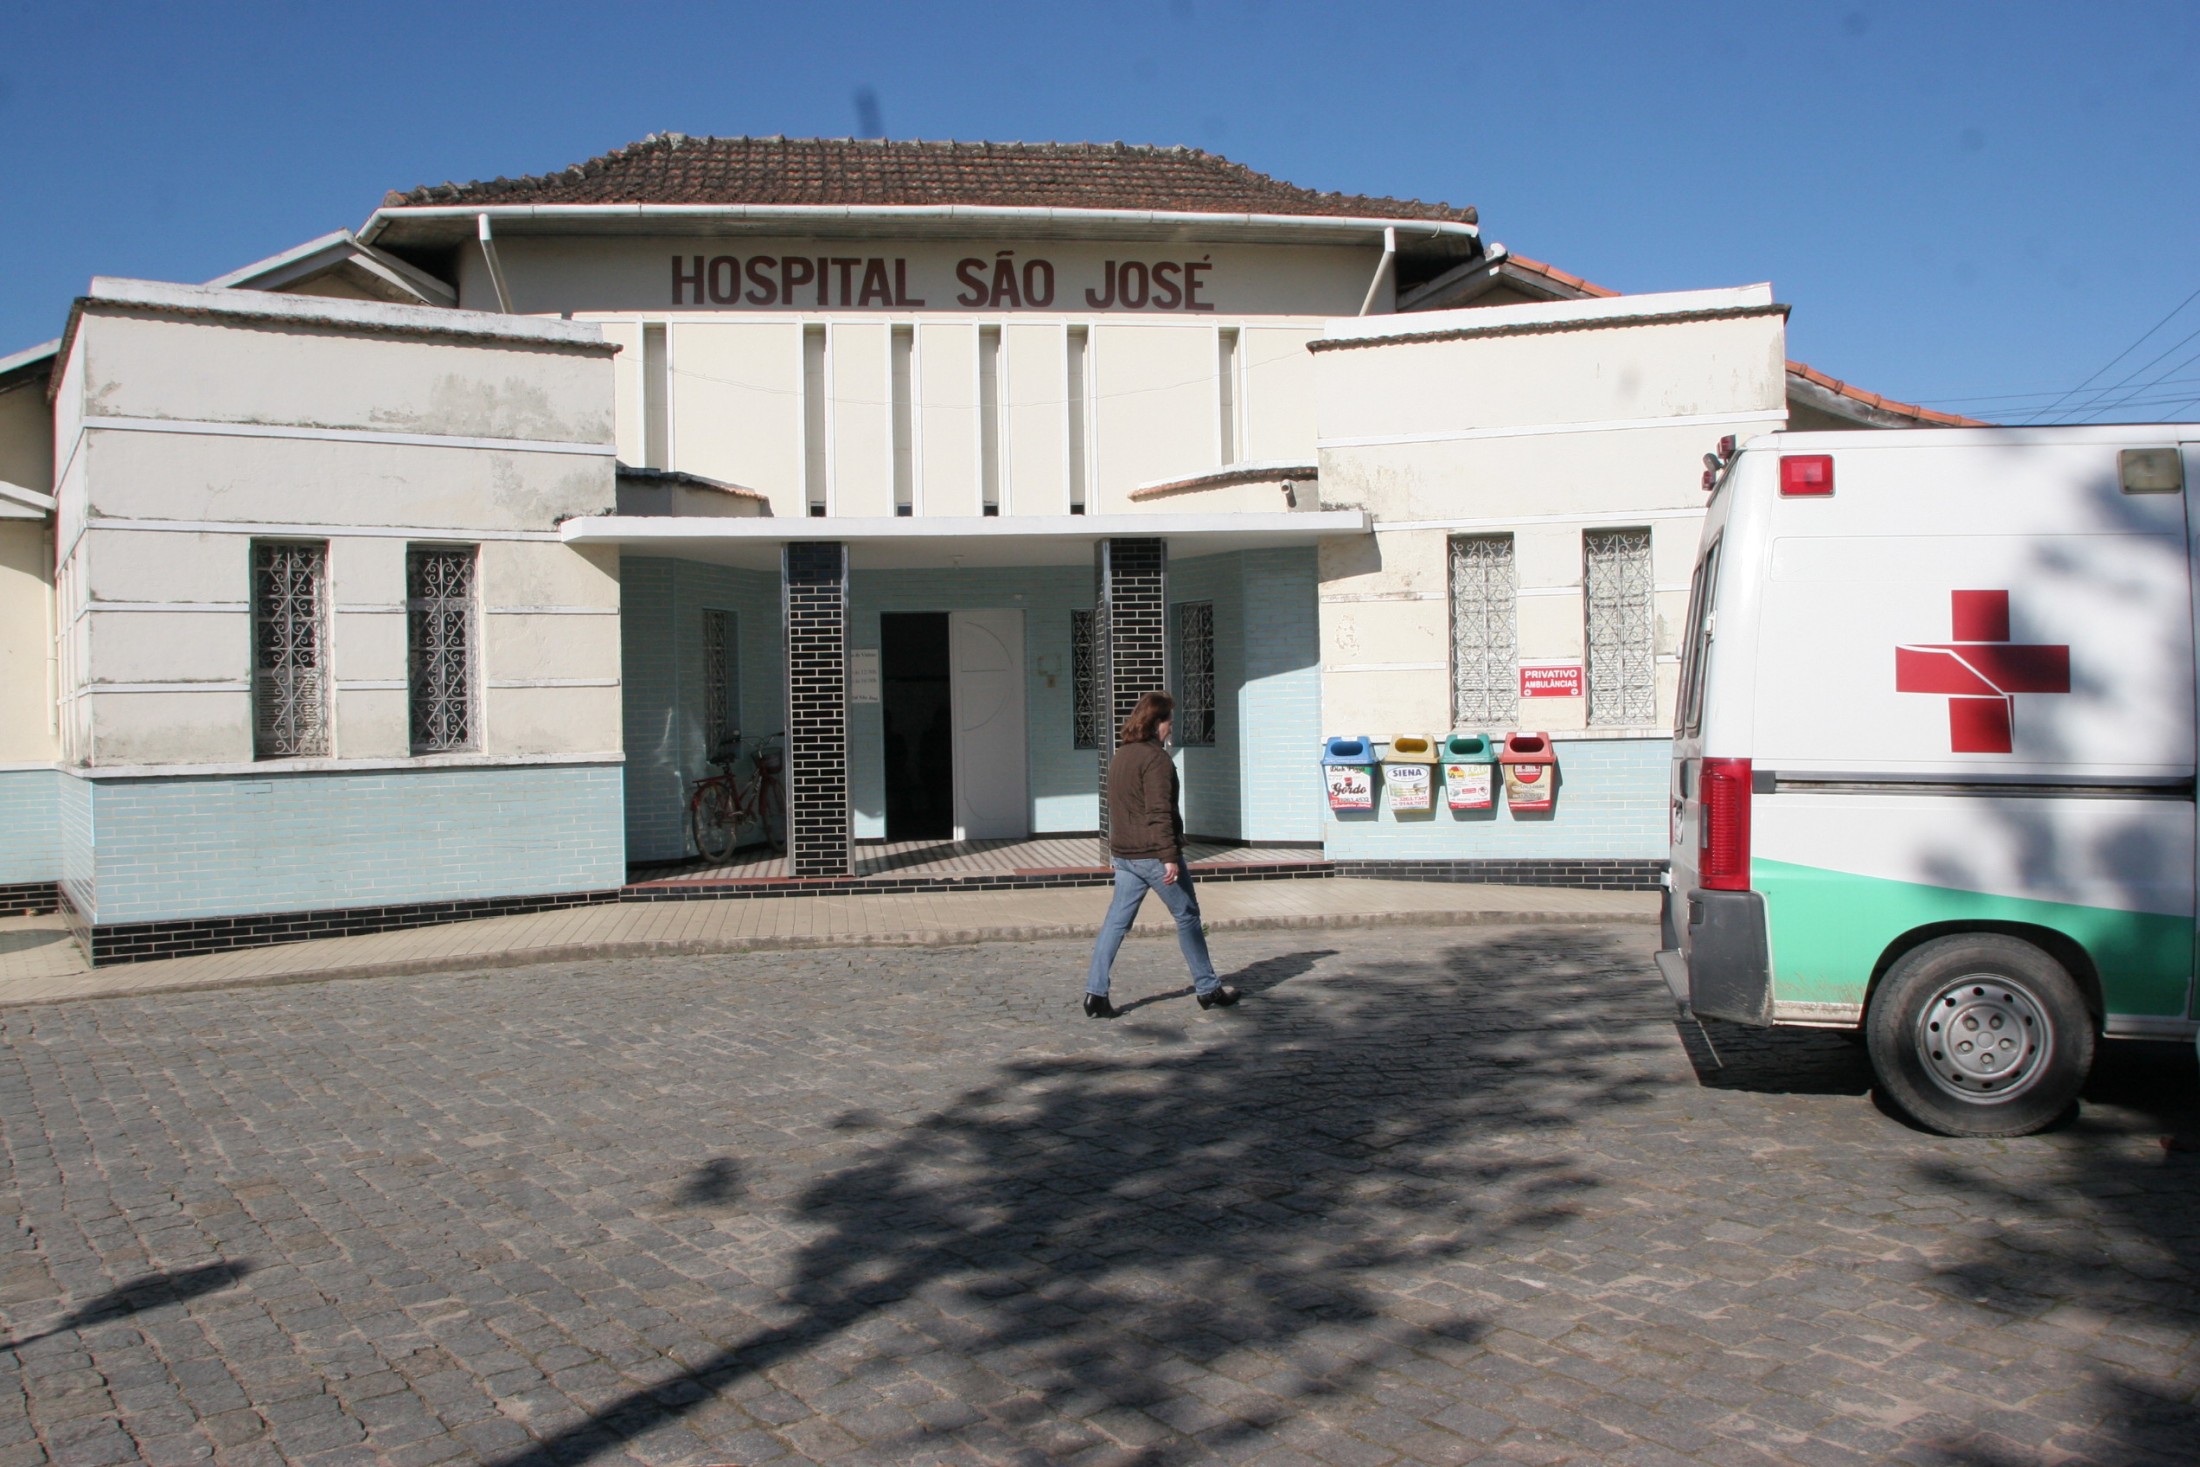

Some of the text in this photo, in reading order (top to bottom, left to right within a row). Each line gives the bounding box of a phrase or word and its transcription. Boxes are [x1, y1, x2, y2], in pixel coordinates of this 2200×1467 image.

[671, 250, 1215, 311] HOSPITAL SÃO JOSÉ
[1524, 669, 1578, 679] PRIVATIVO
[1524, 679, 1578, 688] AMBULÂNCIAS
[1392, 768, 1423, 777] SIENA
[1331, 782, 1367, 796] Gordo
